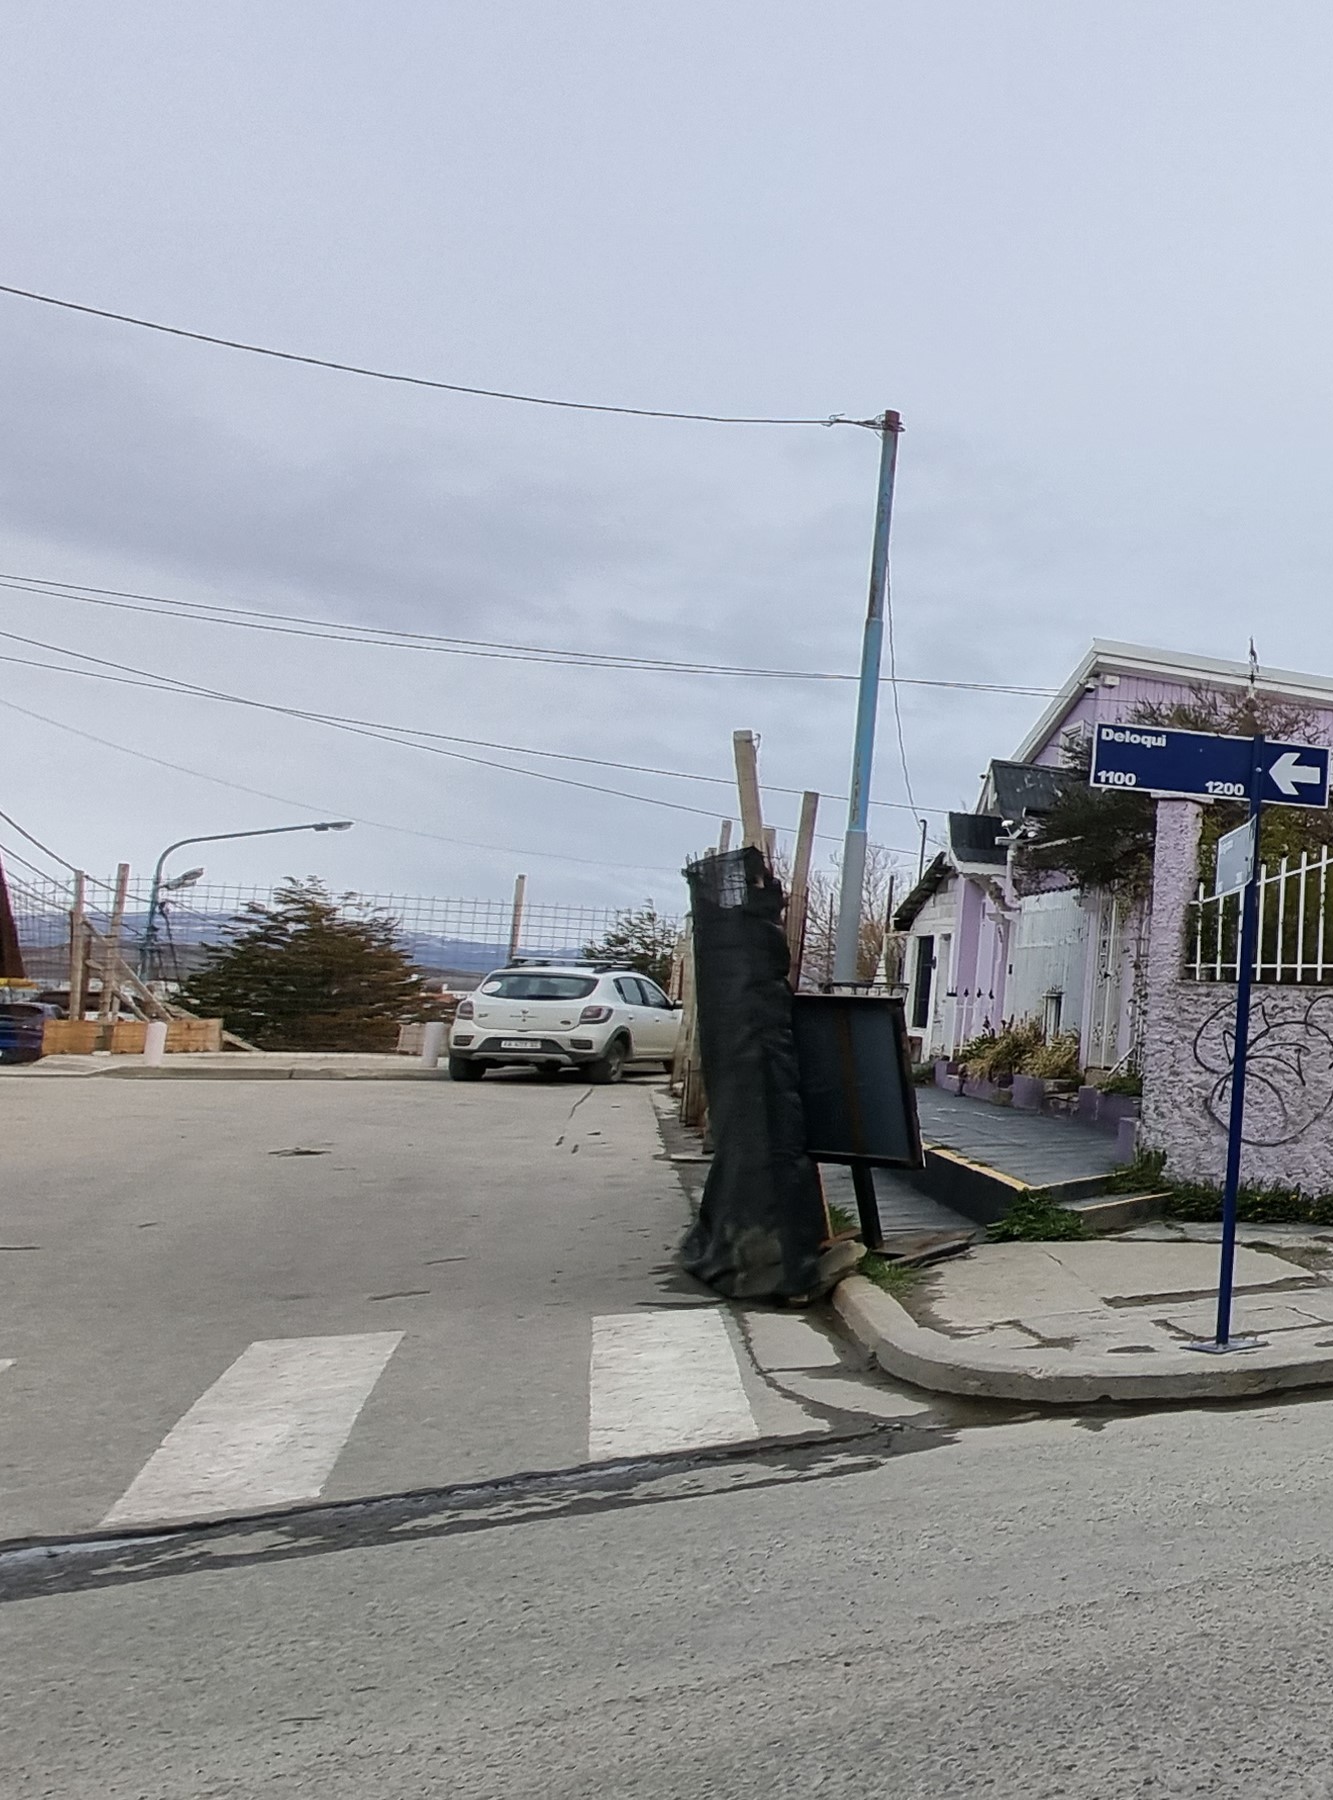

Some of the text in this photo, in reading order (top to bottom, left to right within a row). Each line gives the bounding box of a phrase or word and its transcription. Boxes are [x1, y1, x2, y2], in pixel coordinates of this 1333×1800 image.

[1101, 728, 1167, 748] Deloqui
[1098, 770, 1245, 796] 1100 1200
